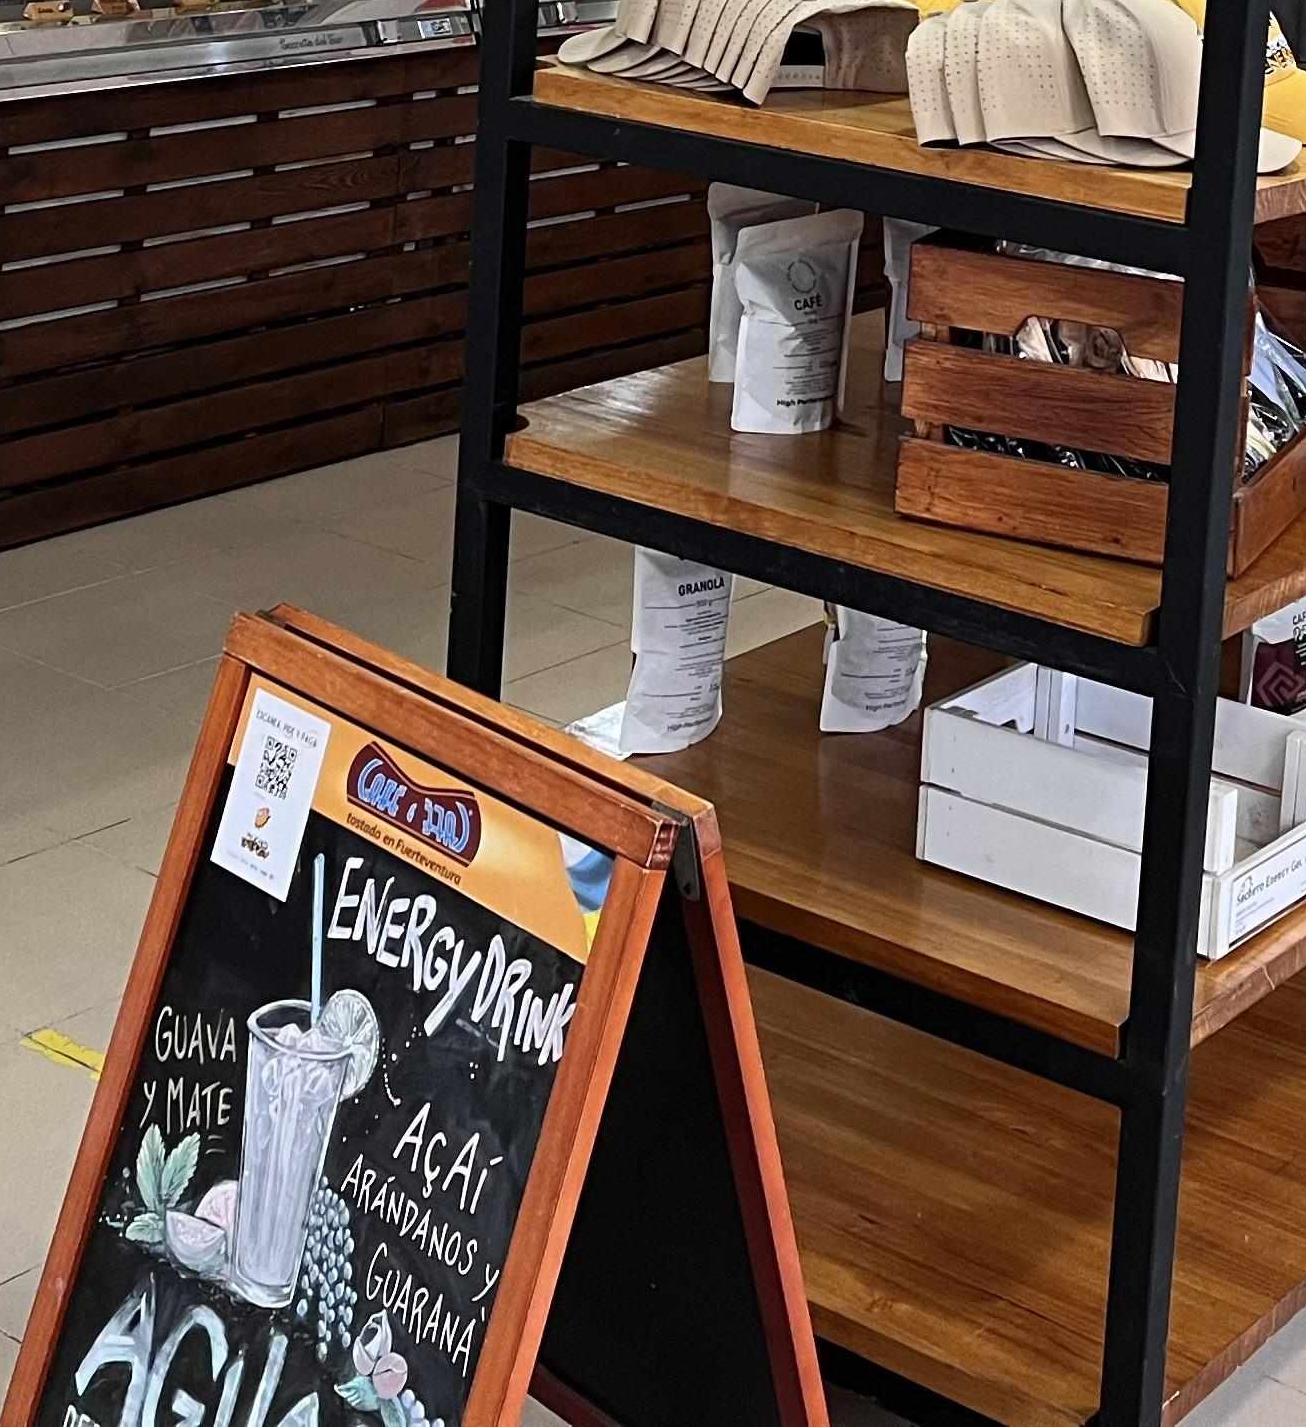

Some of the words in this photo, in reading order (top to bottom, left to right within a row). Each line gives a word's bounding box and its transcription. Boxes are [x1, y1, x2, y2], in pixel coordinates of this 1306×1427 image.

[794, 294, 823, 312] CAFÉ
[678, 576, 725, 597] GRANOLA
[346, 812, 382, 841] tostado
[382, 831, 396, 849] en
[396, 838, 462, 886] Fuerteventura
[327, 856, 482, 1037] ENERGY
[470, 934, 577, 1066] DRINK
[155, 1005, 237, 1064] GUAVA
[166, 1077, 234, 1135] MATE
[341, 1153, 478, 1275] ARÁNDANOS
[366, 1242, 487, 1377] GUARANÁ
